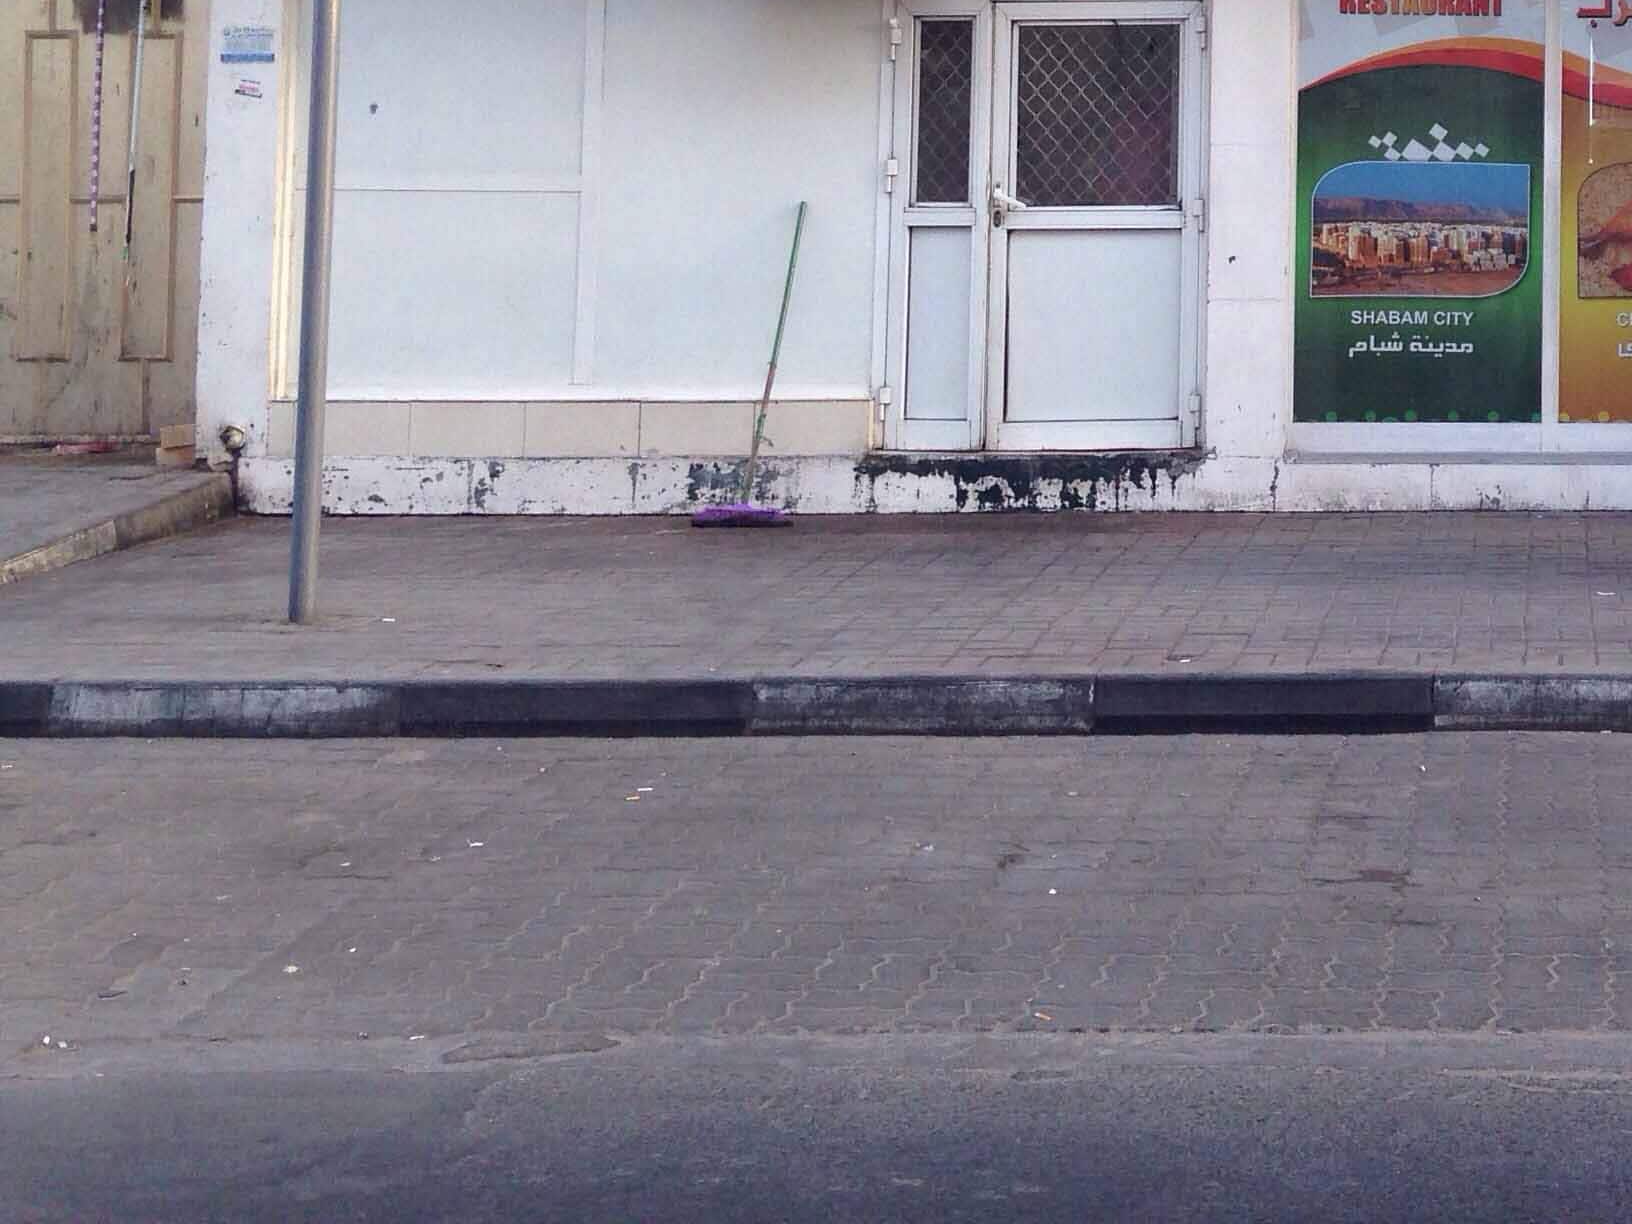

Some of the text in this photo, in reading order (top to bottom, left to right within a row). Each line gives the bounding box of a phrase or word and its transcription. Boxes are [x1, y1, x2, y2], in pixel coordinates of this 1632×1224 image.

[1350, 309, 1474, 326] SHABAM CITY
[1348, 331, 1474, 358] مدينة شبام
